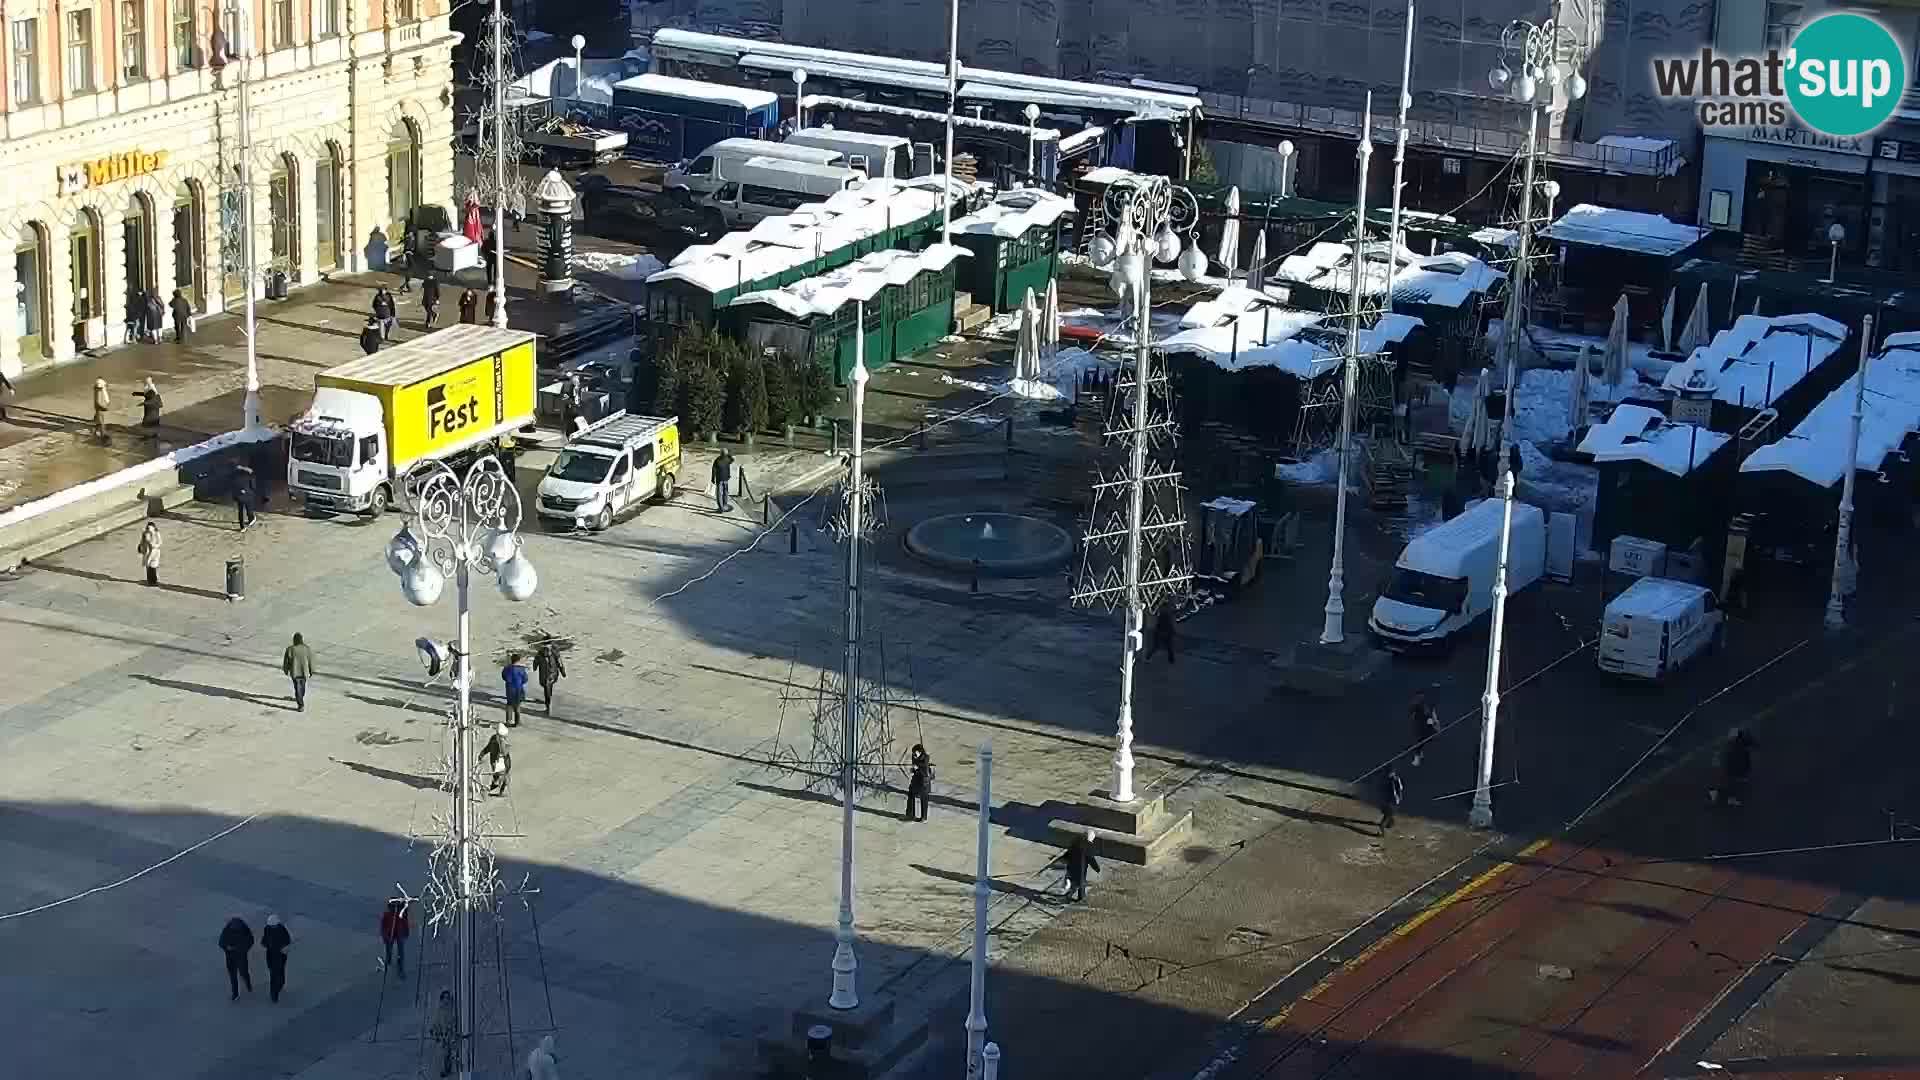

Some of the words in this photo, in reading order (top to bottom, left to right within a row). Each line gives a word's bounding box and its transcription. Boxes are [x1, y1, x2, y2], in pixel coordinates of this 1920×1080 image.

[1751, 127, 1863, 152] MARTIMEX
[87, 149, 168, 187] Müller
[430, 395, 480, 440] Fest
